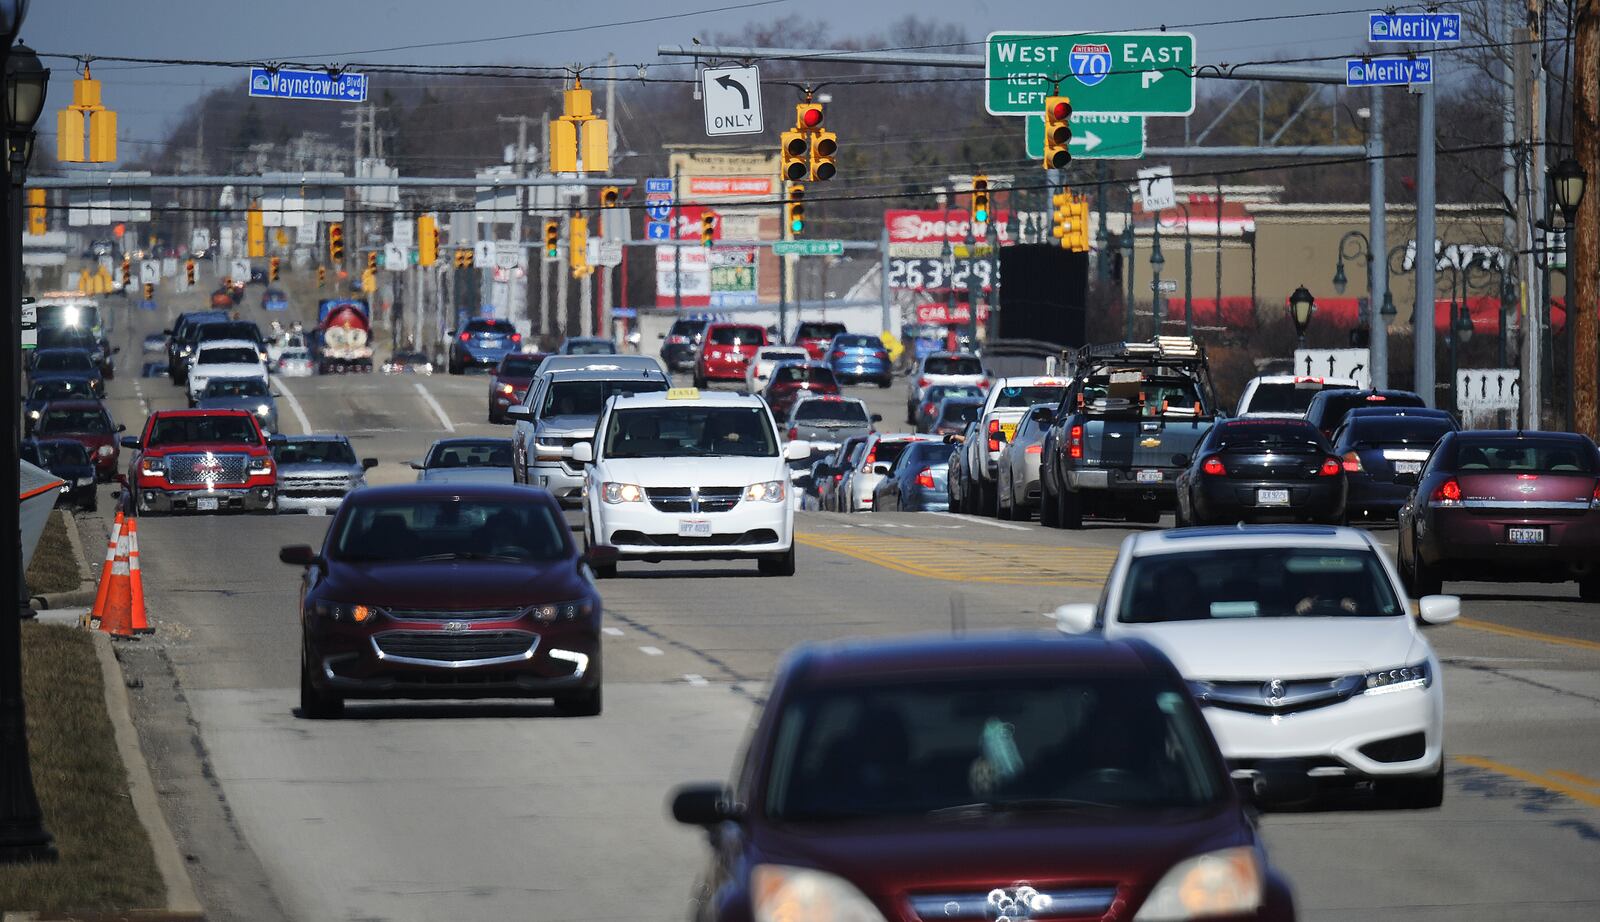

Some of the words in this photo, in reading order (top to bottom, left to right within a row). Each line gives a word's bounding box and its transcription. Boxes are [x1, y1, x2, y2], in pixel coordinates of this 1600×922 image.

[1389, 17, 1441, 40] Merily
[1442, 17, 1458, 29] Way
[997, 43, 1059, 63] WEST
[1123, 43, 1183, 63] EAST
[1074, 54, 1107, 78] 70
[1365, 62, 1414, 82] Merily
[1415, 61, 1429, 71] Way
[271, 74, 346, 97] Waynetowne
[346, 77, 361, 88] Blvd
[1007, 73, 1048, 86] KEEP
[1008, 92, 1047, 105] LEFT
[715, 114, 753, 129] ONLY
[649, 181, 670, 191] WEST
[647, 200, 671, 216] 70
[1146, 197, 1171, 207] ONLY
[672, 388, 695, 396] TAXI
